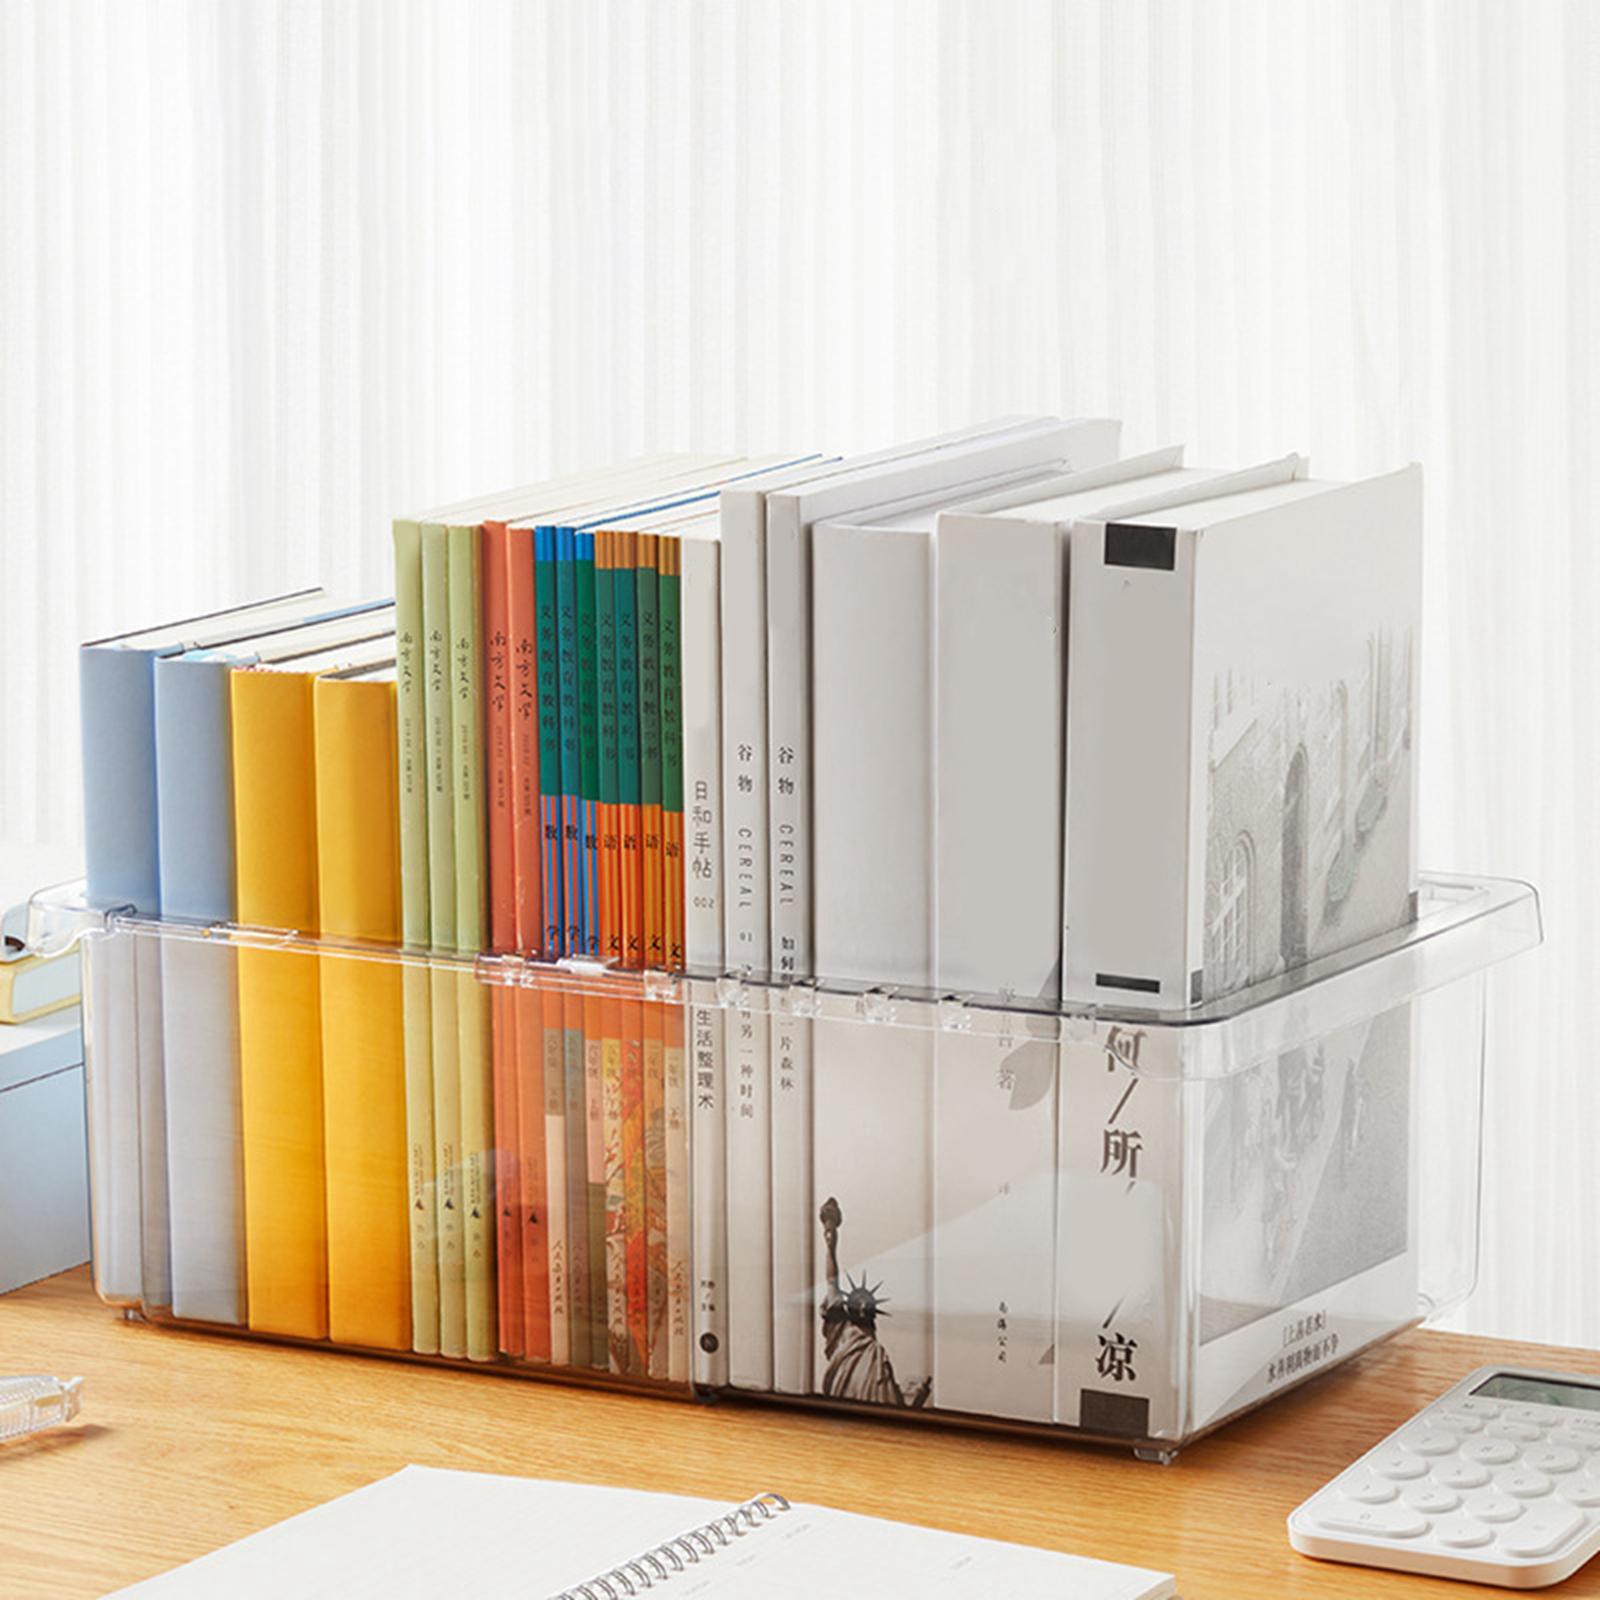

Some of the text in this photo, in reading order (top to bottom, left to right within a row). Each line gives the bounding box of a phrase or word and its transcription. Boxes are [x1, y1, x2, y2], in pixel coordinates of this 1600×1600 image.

[738, 744, 752, 793] 谷物
[778, 746, 795, 795] 谷物
[738, 828, 753, 908] CEREAL
[779, 824, 795, 904] CEREAL
[696, 1010, 714, 1110] 生活整理术
